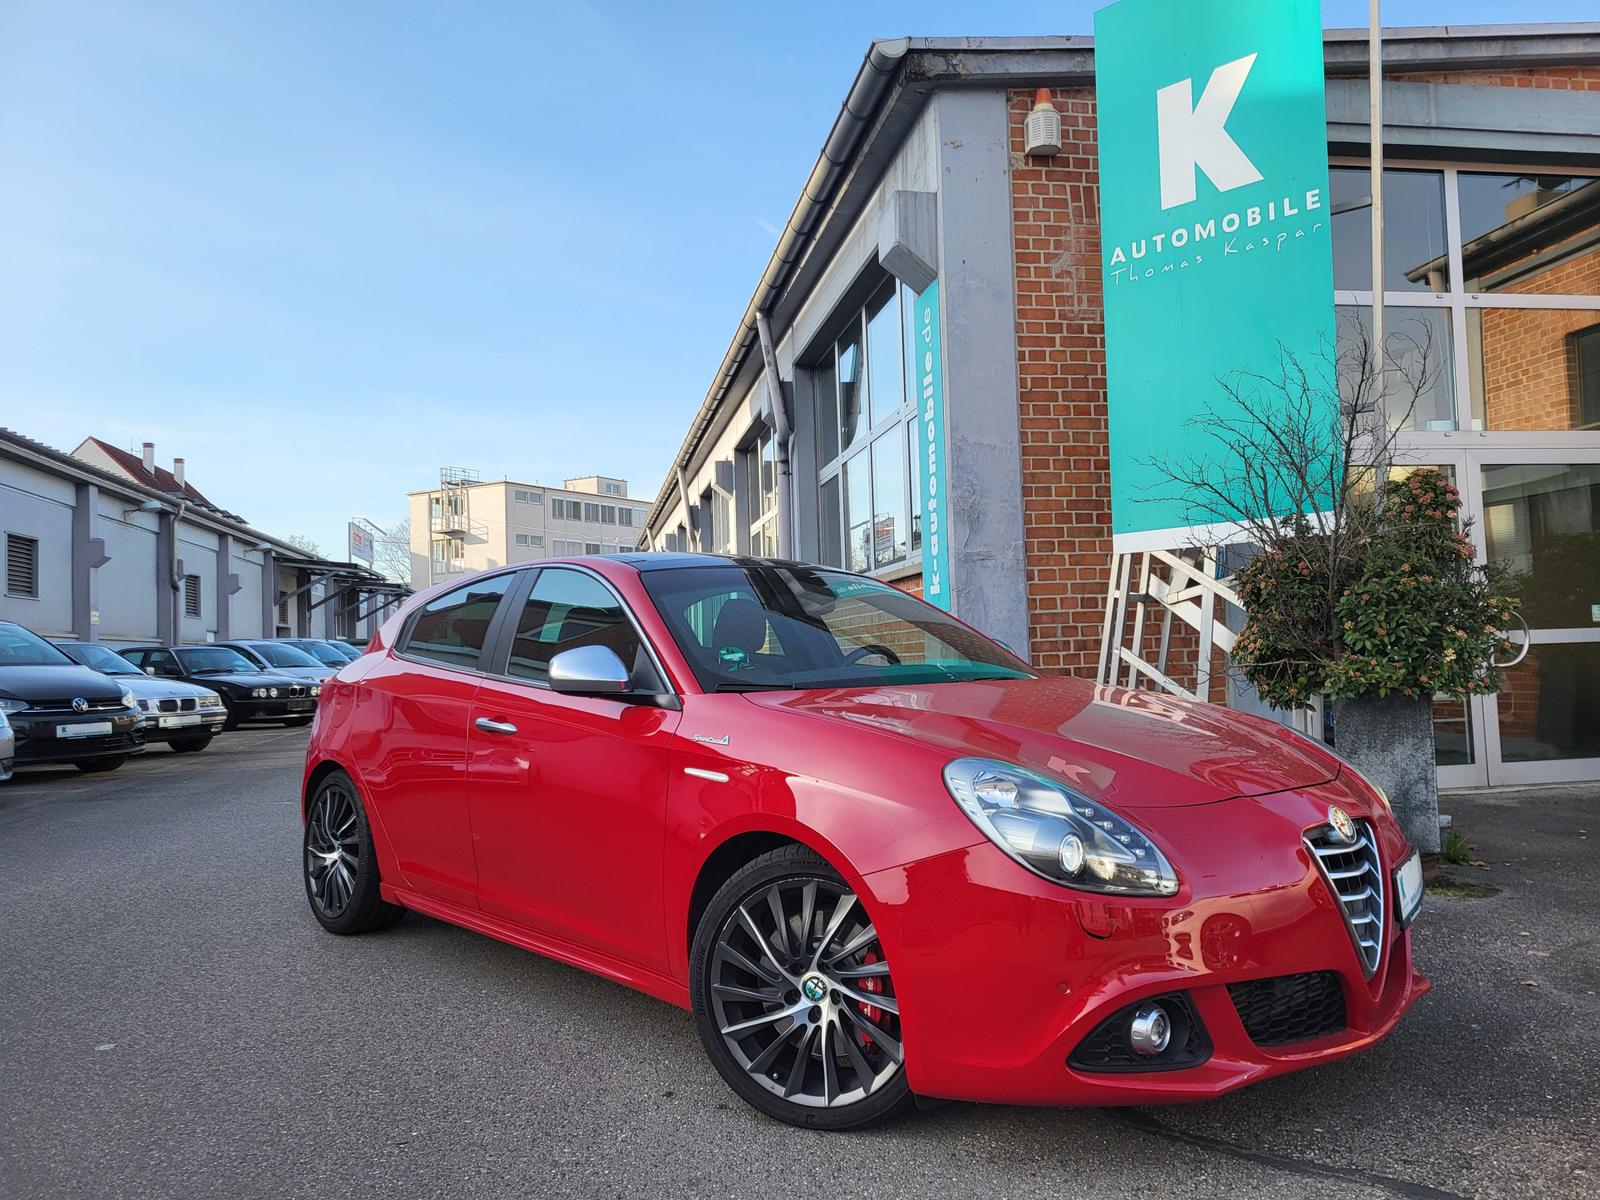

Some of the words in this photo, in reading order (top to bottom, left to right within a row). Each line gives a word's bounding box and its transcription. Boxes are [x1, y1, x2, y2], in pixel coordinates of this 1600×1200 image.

[1157, 52, 1264, 211] K
[1110, 188, 1322, 266] AUTOMOBILE
[1110, 255, 1203, 286] Thomas
[1223, 223, 1322, 256] Kaspar
[922, 306, 941, 595] k-automobile.de
